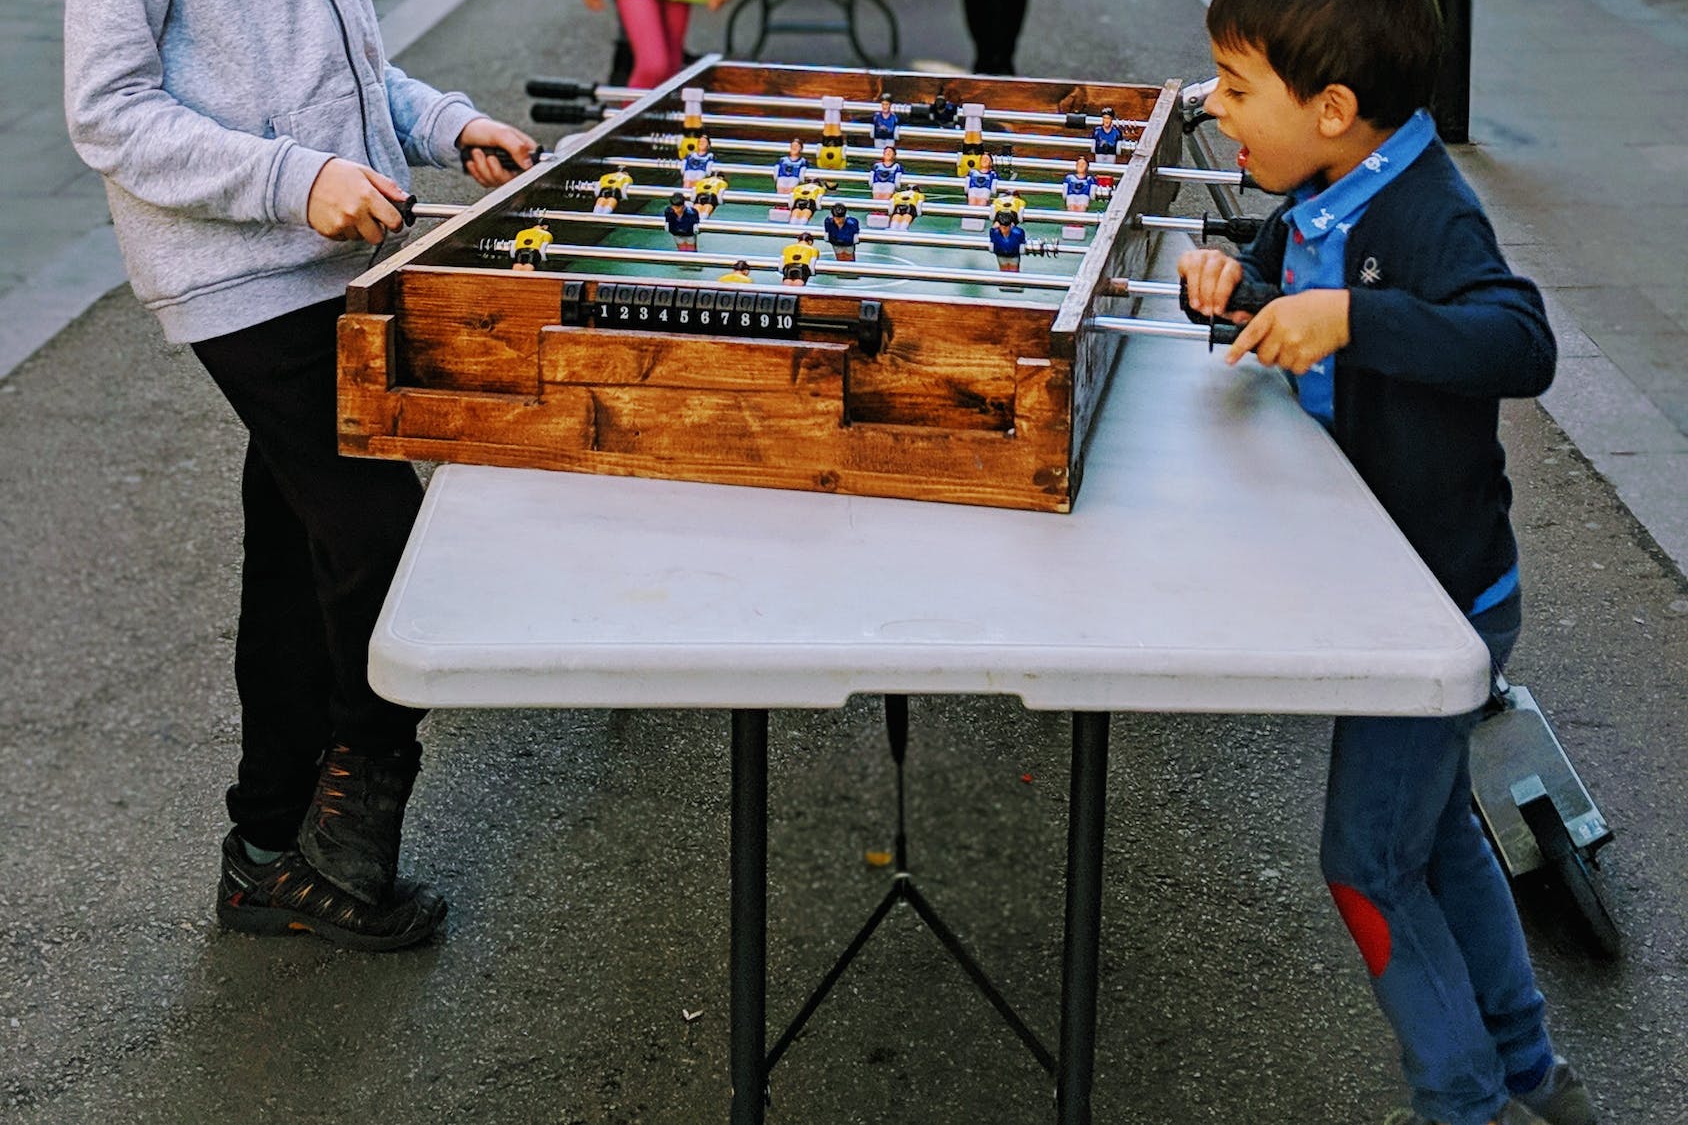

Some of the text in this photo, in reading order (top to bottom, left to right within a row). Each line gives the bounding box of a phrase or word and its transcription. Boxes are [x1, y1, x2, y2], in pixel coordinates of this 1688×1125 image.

[601, 305, 792, 329] 1 2 3 4 5 6 7 8 9 10
